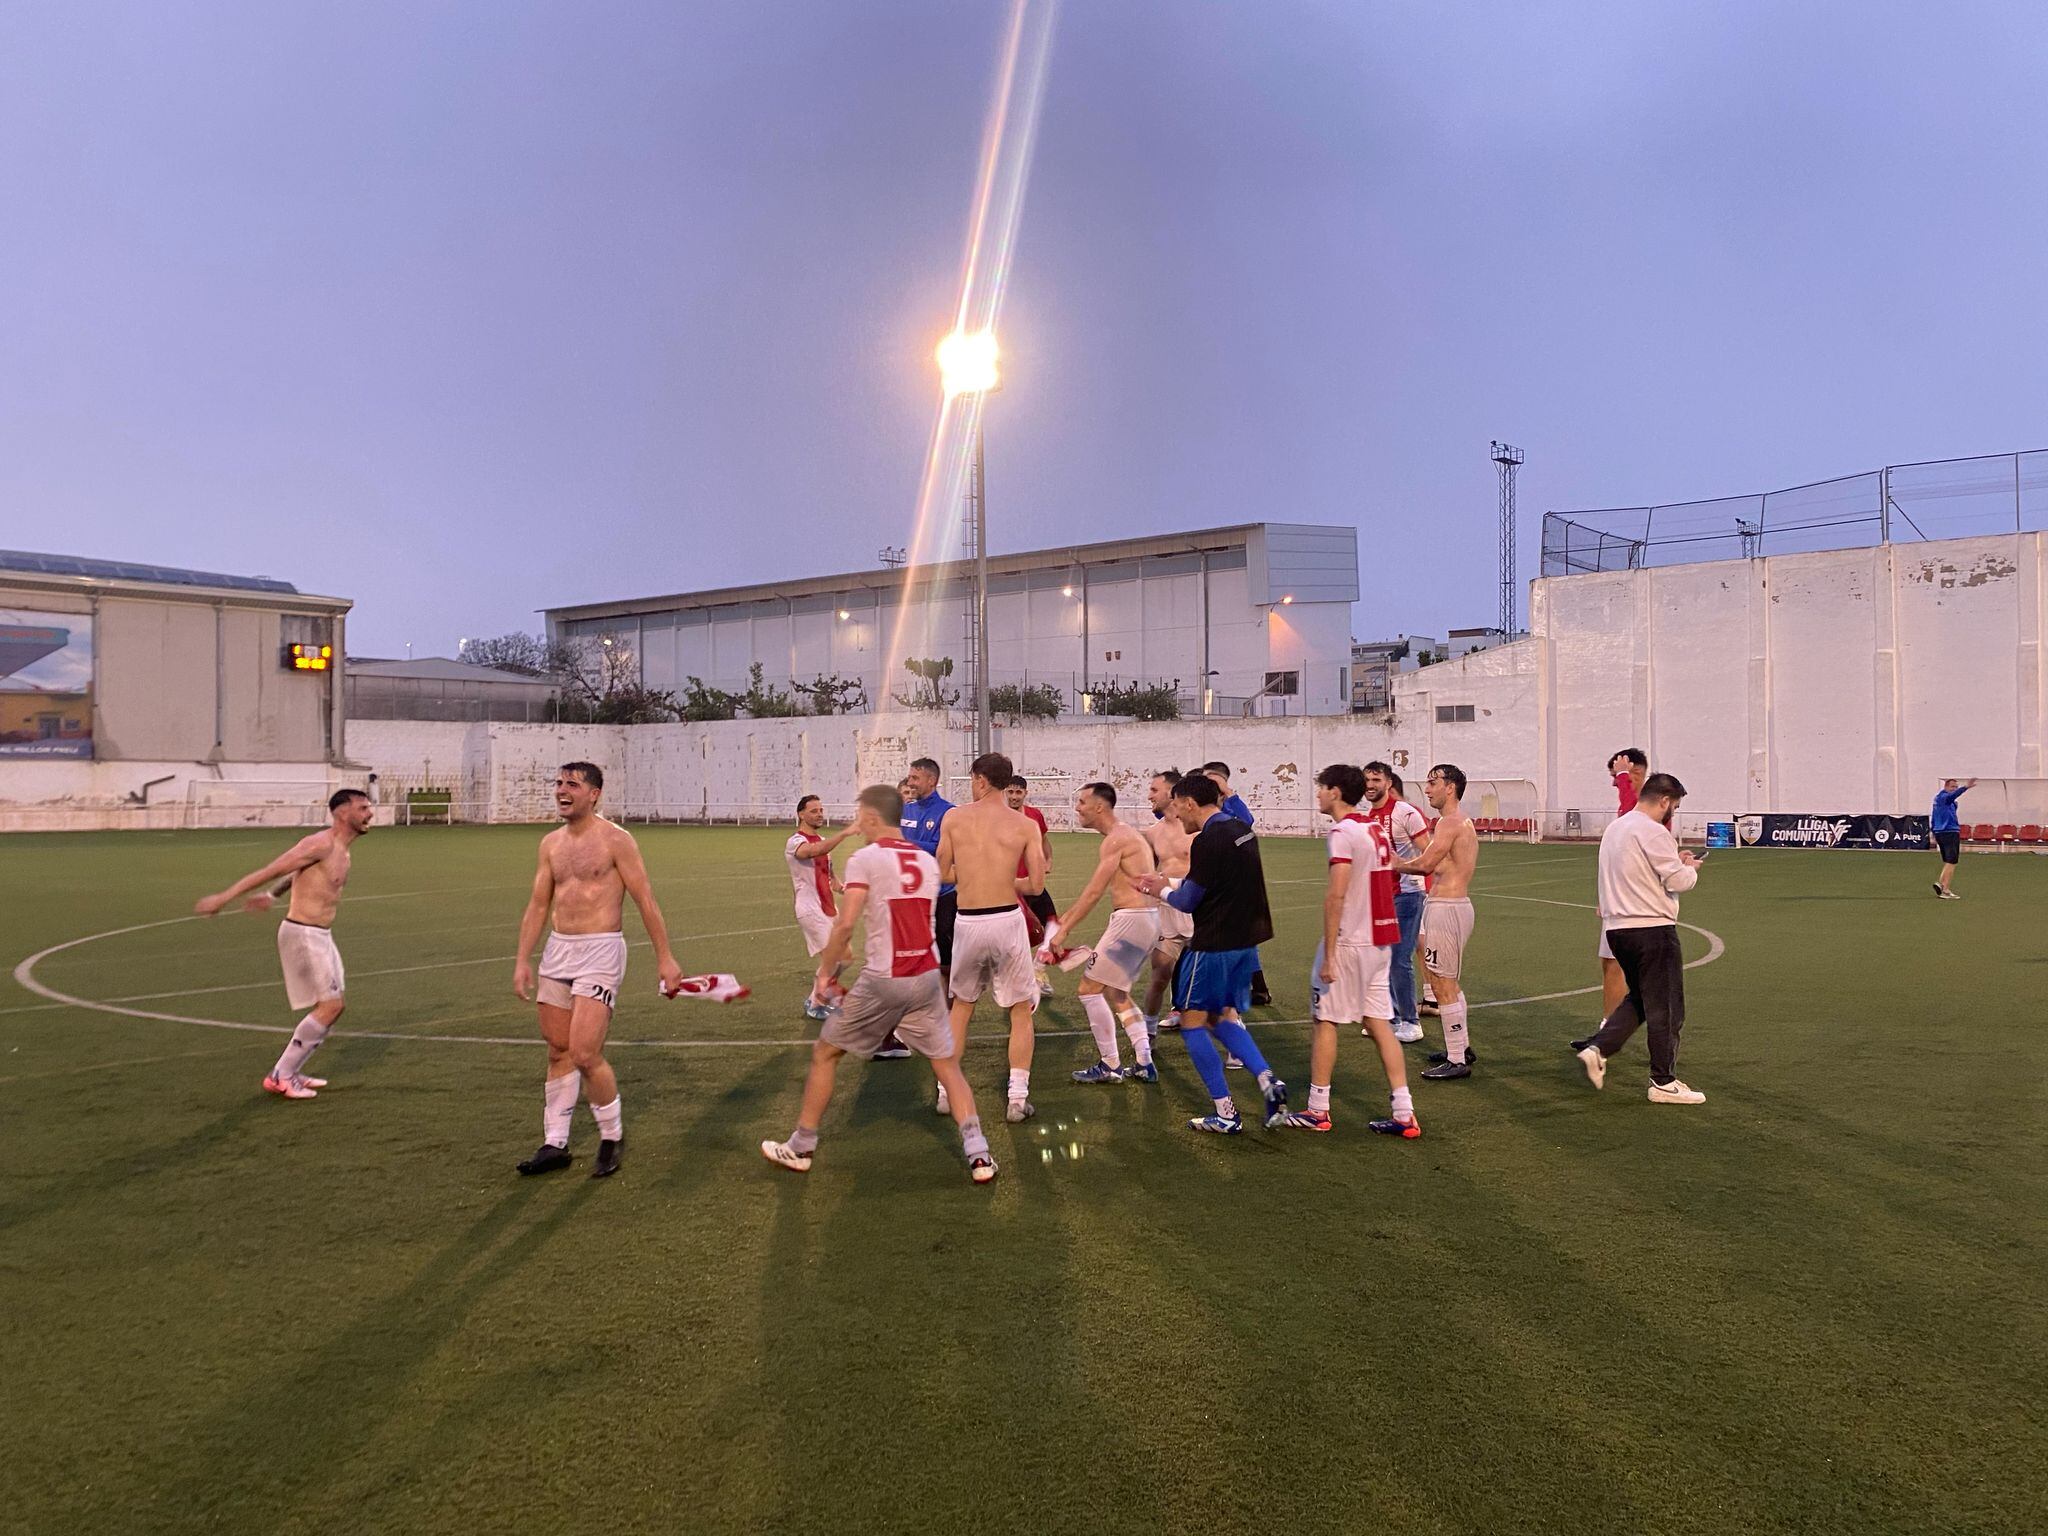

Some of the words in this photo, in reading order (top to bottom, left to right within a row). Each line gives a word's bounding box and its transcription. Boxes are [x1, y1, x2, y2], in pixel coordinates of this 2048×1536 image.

[1797, 820, 1828, 830] LLIGA
[1772, 830, 1833, 842] COMUNITAT
[896, 851, 923, 894] 5
[1425, 947, 1438, 964] 21
[592, 984, 612, 1007] 20
